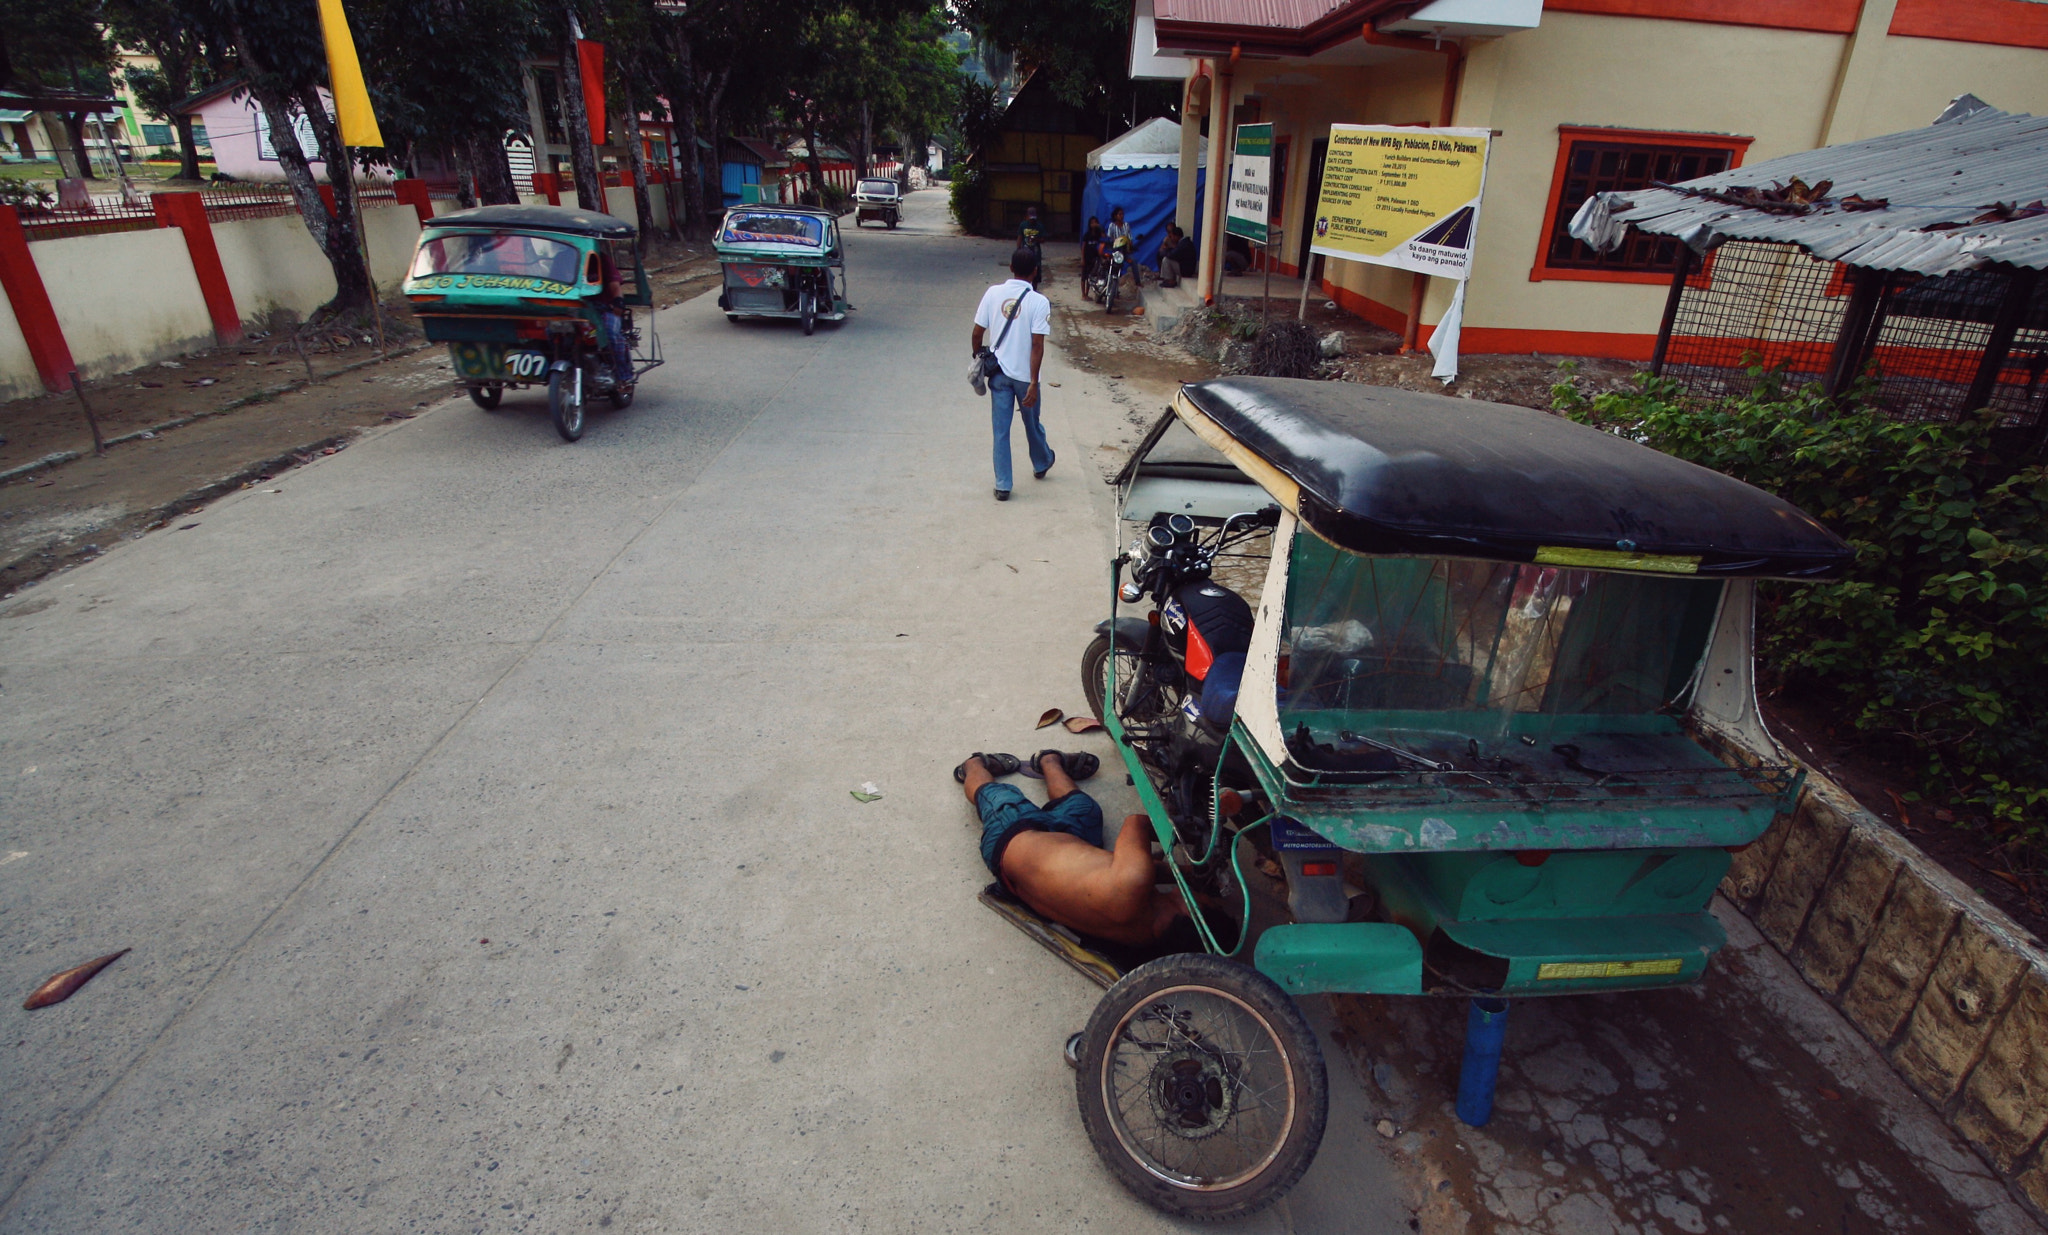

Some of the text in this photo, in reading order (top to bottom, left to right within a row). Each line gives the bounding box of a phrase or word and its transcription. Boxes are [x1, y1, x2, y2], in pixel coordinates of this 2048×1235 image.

[1334, 135, 1362, 145] Construction
[1363, 136, 1368, 146] of
[1369, 136, 1380, 146] New
[1404, 138, 1430, 152] Poblacion,
[1432, 140, 1438, 150] El
[1438, 141, 1452, 153] Nido,
[1453, 141, 1477, 153] Palawan
[1446, 159, 1460, 167] Supply
[1332, 216, 1356, 225] DEPARTMENT
[1367, 229, 1388, 238] HIGHWAYS
[1412, 252, 1466, 268] kayo ang panalo!
[1418, 246, 1436, 256] daang
[1438, 250, 1468, 261] matuwid,
[457, 276, 533, 289] JOHANN
[532, 280, 573, 295] JAY
